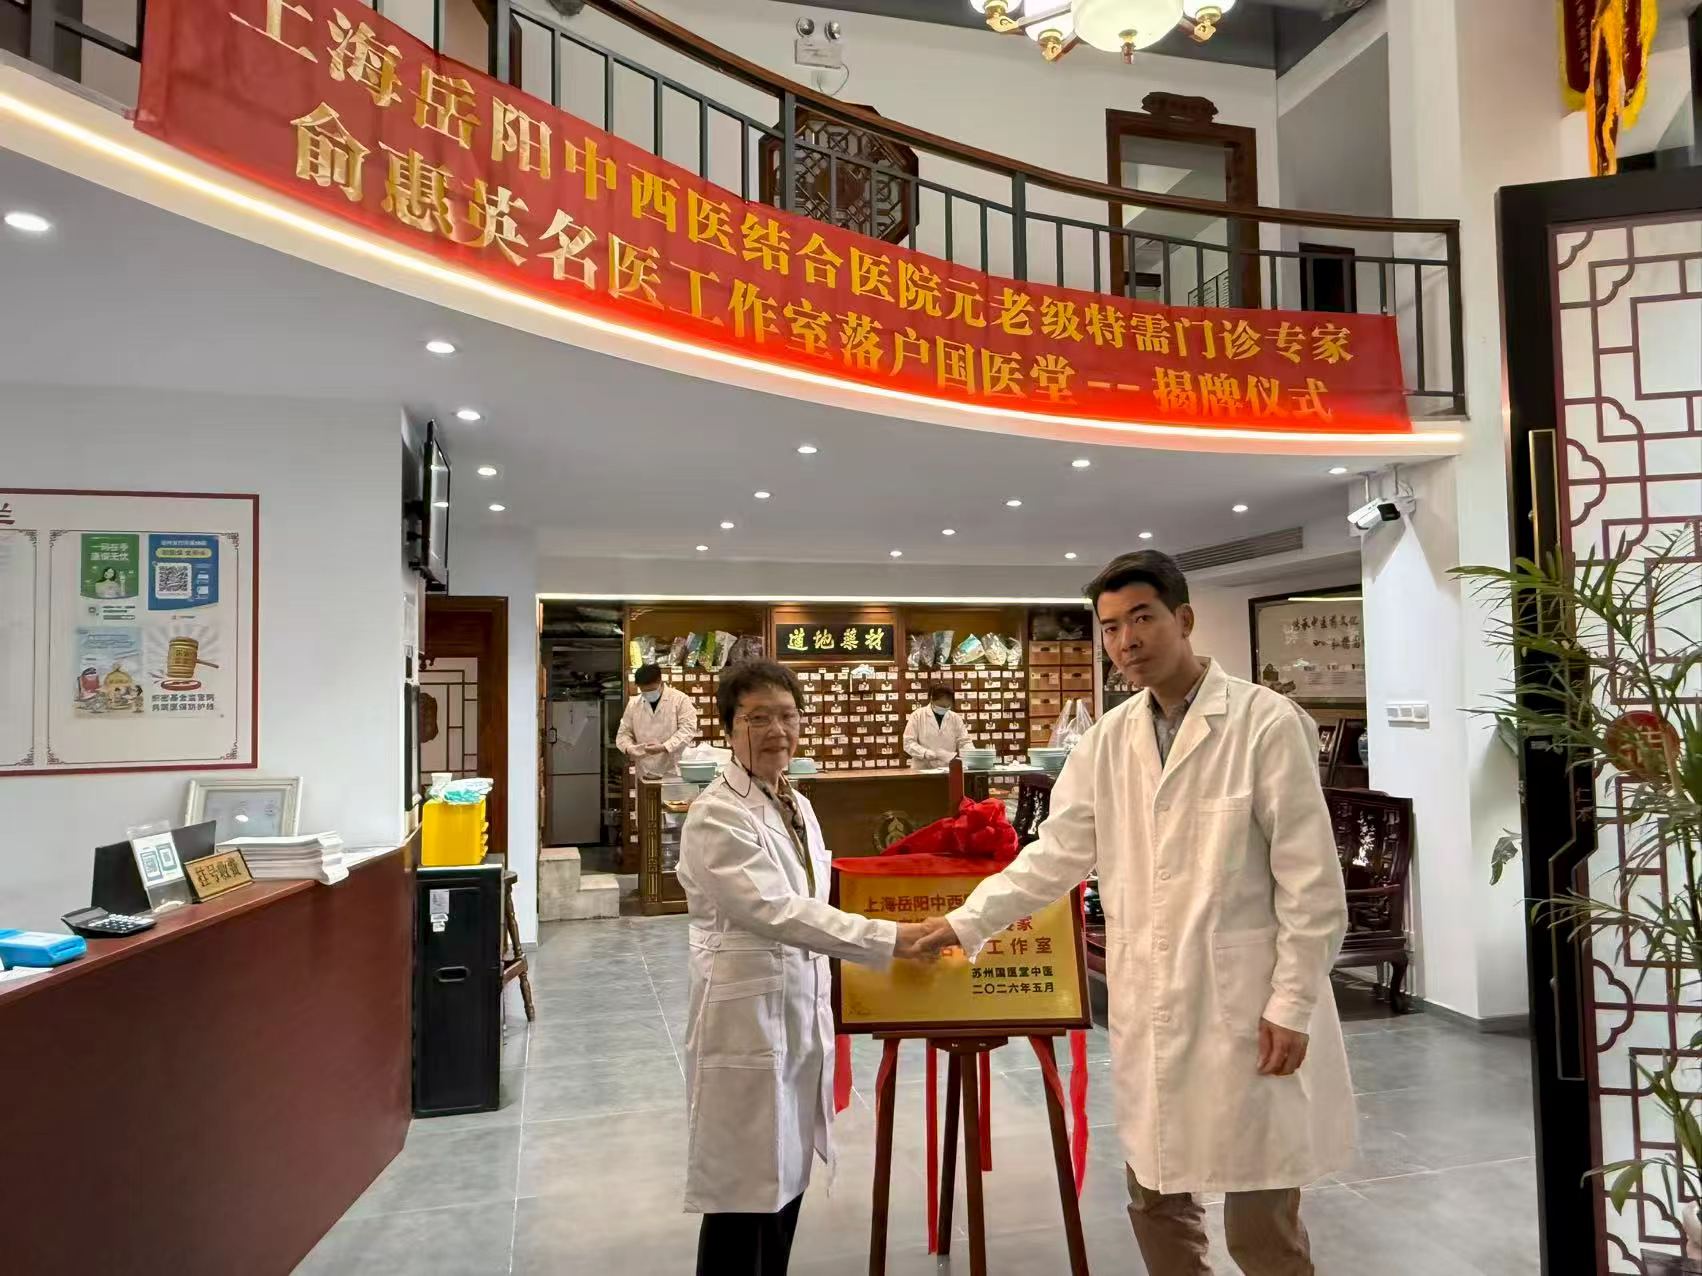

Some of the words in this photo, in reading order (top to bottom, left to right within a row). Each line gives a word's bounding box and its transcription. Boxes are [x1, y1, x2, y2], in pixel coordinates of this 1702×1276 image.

[229, 0, 1354, 364] 上海岳阳中西医结合医院元老级特需门诊专家
[863, 893, 969, 913] 上海岳阳中西
[971, 966, 1053, 978] 苏州国医堂中医
